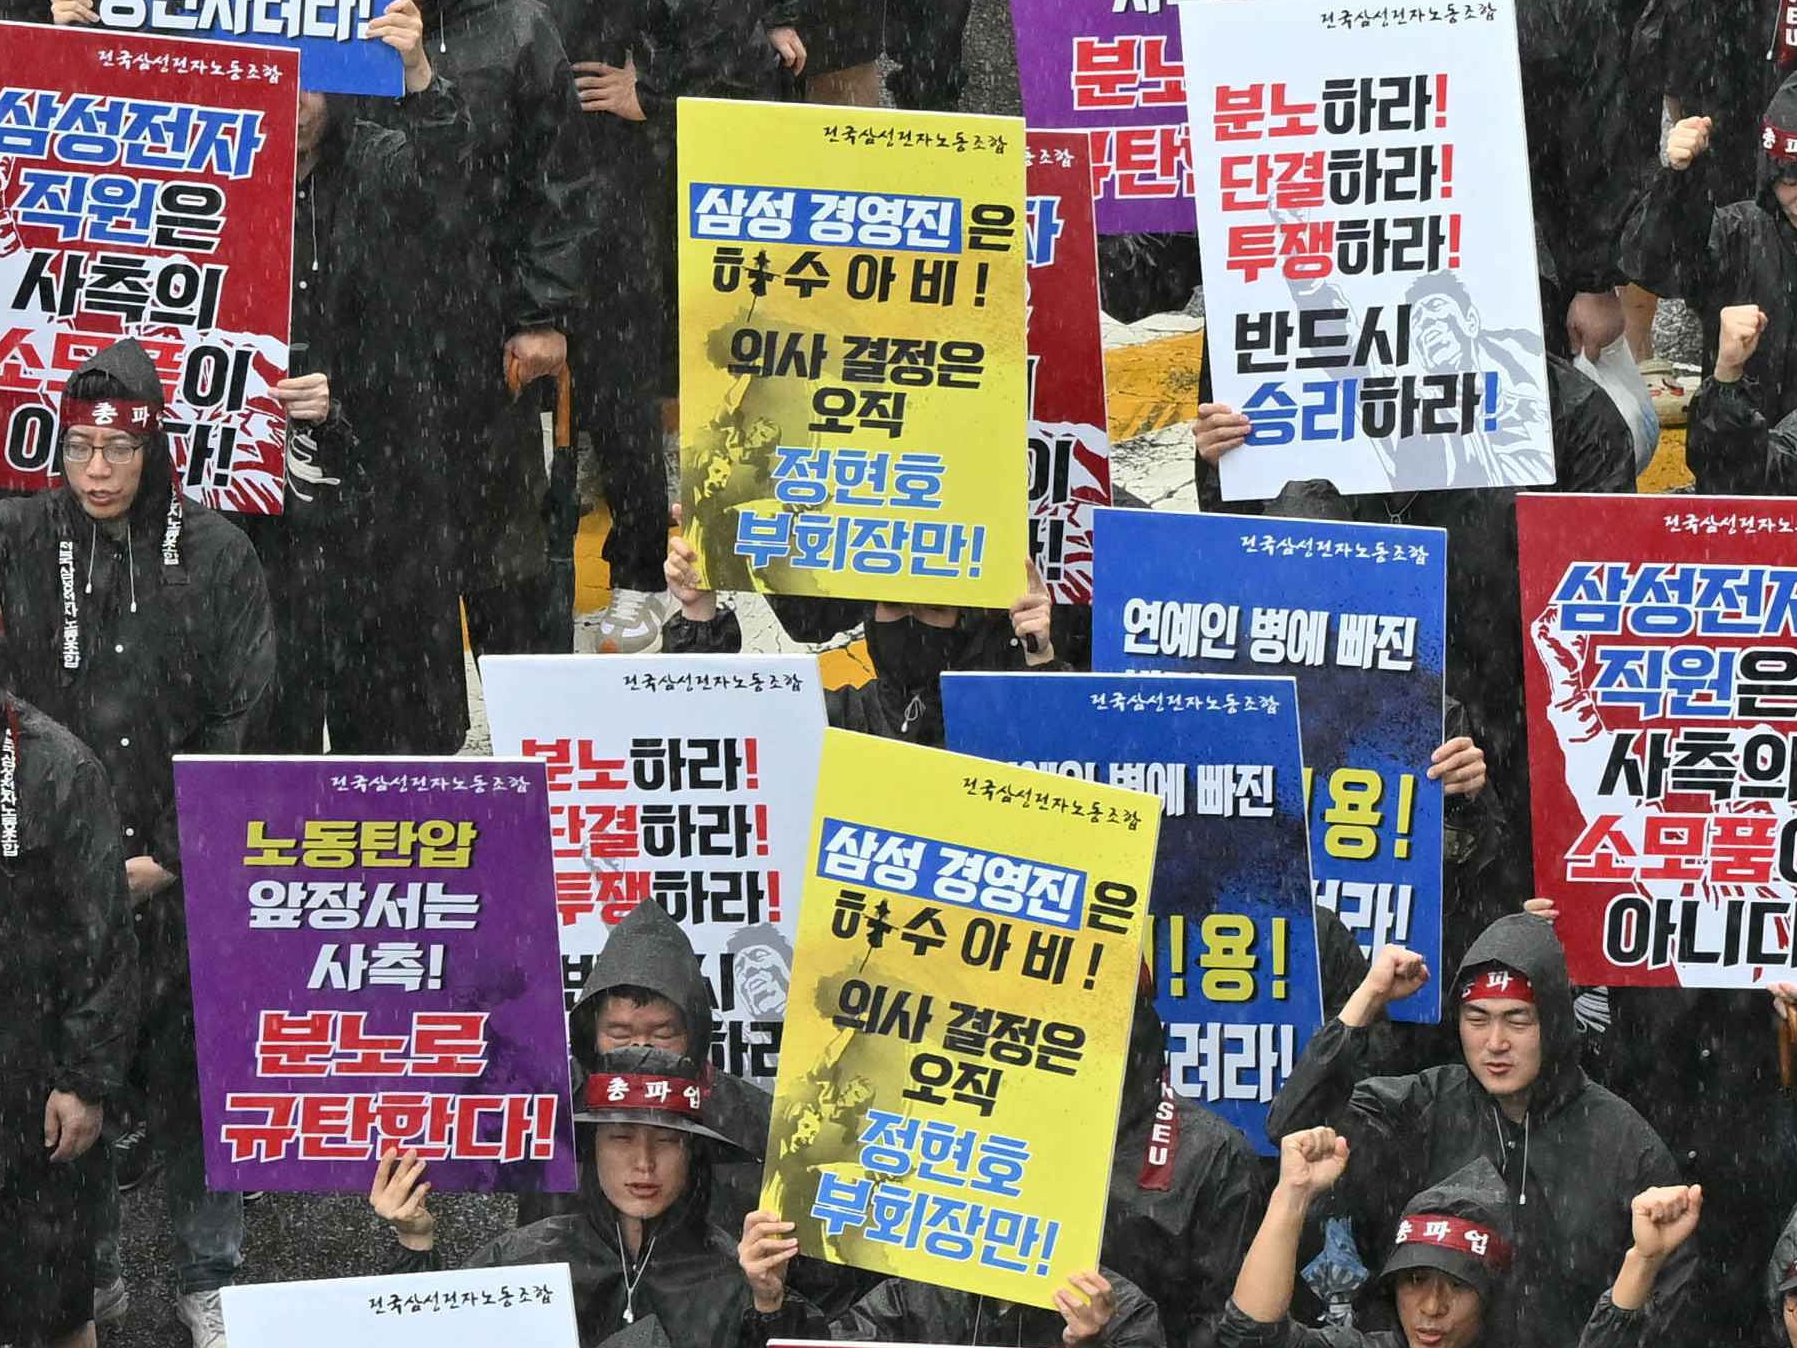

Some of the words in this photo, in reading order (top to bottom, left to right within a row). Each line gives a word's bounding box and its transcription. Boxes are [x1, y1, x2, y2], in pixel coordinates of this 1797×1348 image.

[1213, 74, 1448, 141] 분노하라!
[12, 169, 228, 252] 직원은
[1219, 143, 1453, 211] 단결하라!
[1226, 214, 1461, 283] 투쟁하라!
[11, 250, 227, 330] 사측의
[1235, 305, 1411, 373] 반드시
[1243, 373, 1498, 445] 승리하라!
[243, 821, 477, 868] 노동탄압
[825, 827, 923, 882] 삼성
[248, 881, 479, 930] 앞장서는
[308, 943, 445, 991] 사측!
[256, 1010, 489, 1077] 분노로
[833, 981, 933, 1043] 의사
[945, 1001, 1087, 1076] 결정은
[903, 1053, 1002, 1116] 오직
[221, 1092, 559, 1164] 규탄한다!
[859, 1110, 1031, 1197] 정현호
[809, 1173, 1059, 1275] 부회장만!
